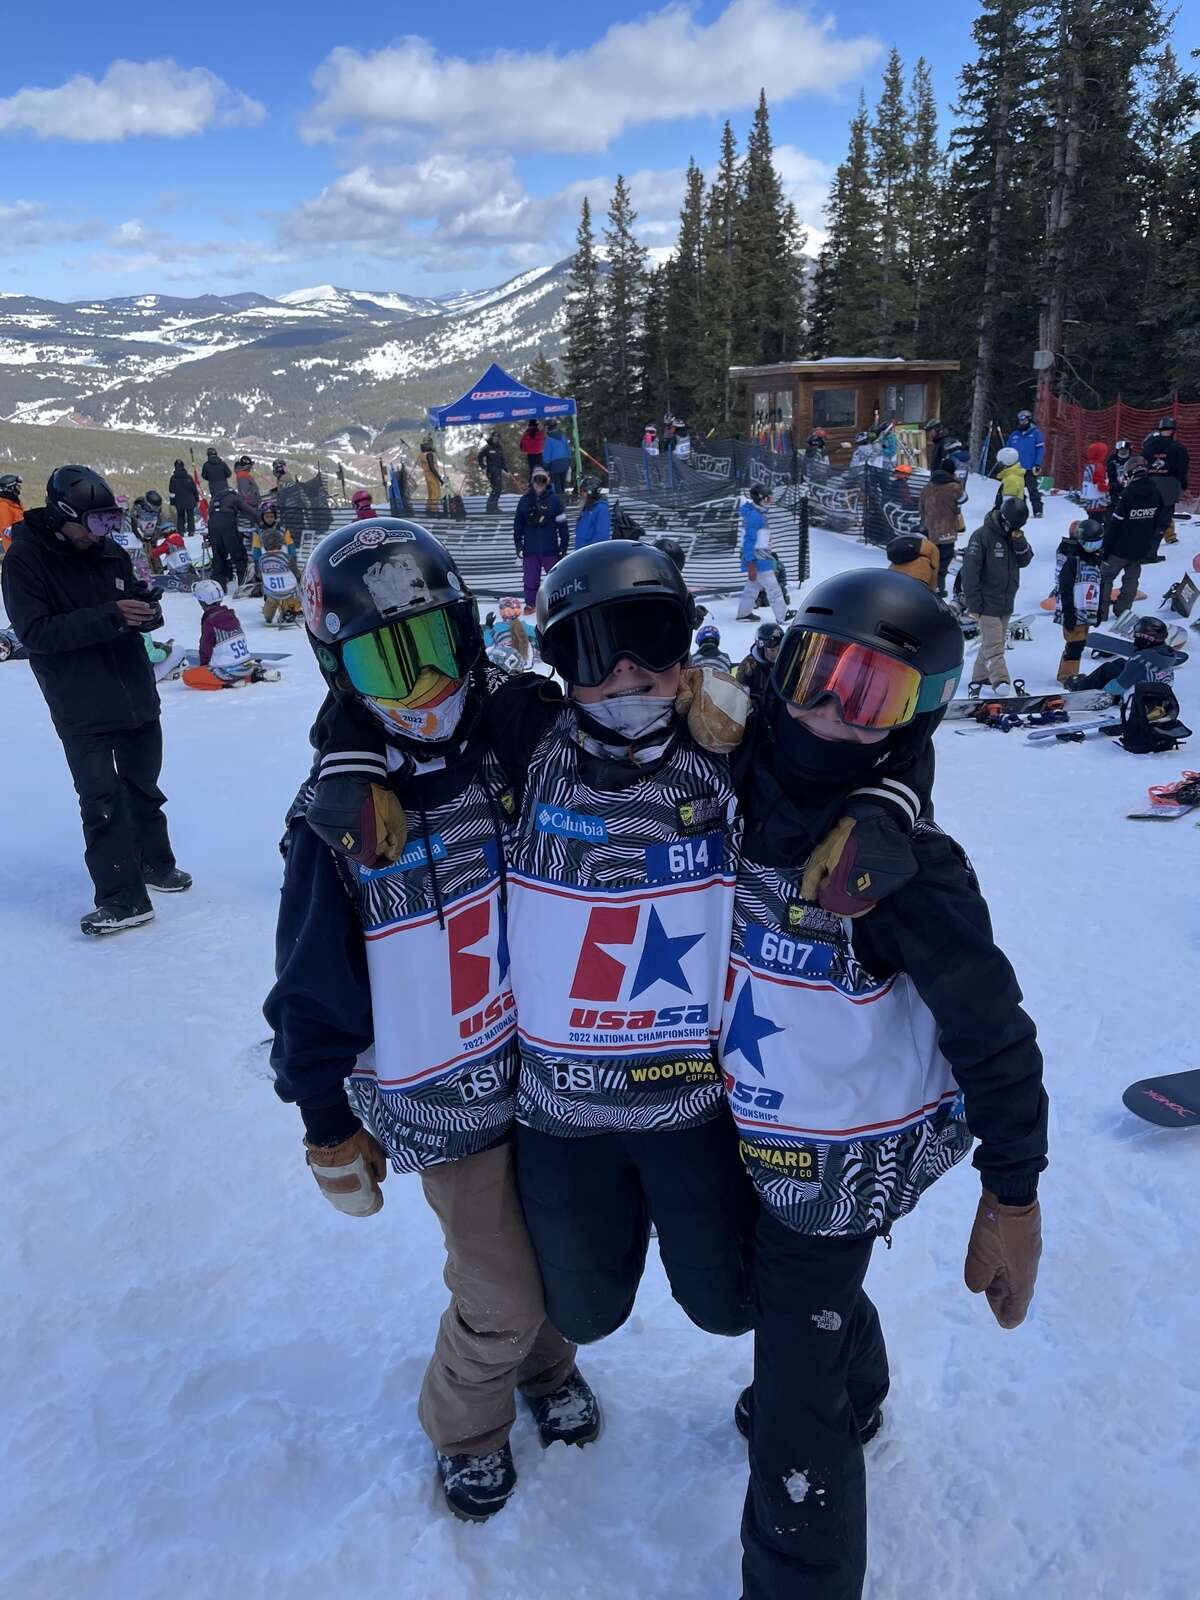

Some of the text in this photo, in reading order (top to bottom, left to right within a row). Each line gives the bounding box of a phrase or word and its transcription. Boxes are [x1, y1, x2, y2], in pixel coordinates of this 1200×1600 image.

[269, 576, 285, 589] 611
[551, 811, 605, 837] Columbia
[668, 839, 709, 873] 614
[760, 932, 814, 970] 607
[463, 1035, 485, 1051] 2022
[484, 1013, 514, 1042] NATIONAL
[568, 1027, 710, 1044] 2022 NATIONAL CHAMPIONSHIPS
[394, 1122, 410, 1137] EM
[413, 1131, 447, 1148] RIDE!
[800, 1169, 812, 1178] CO
